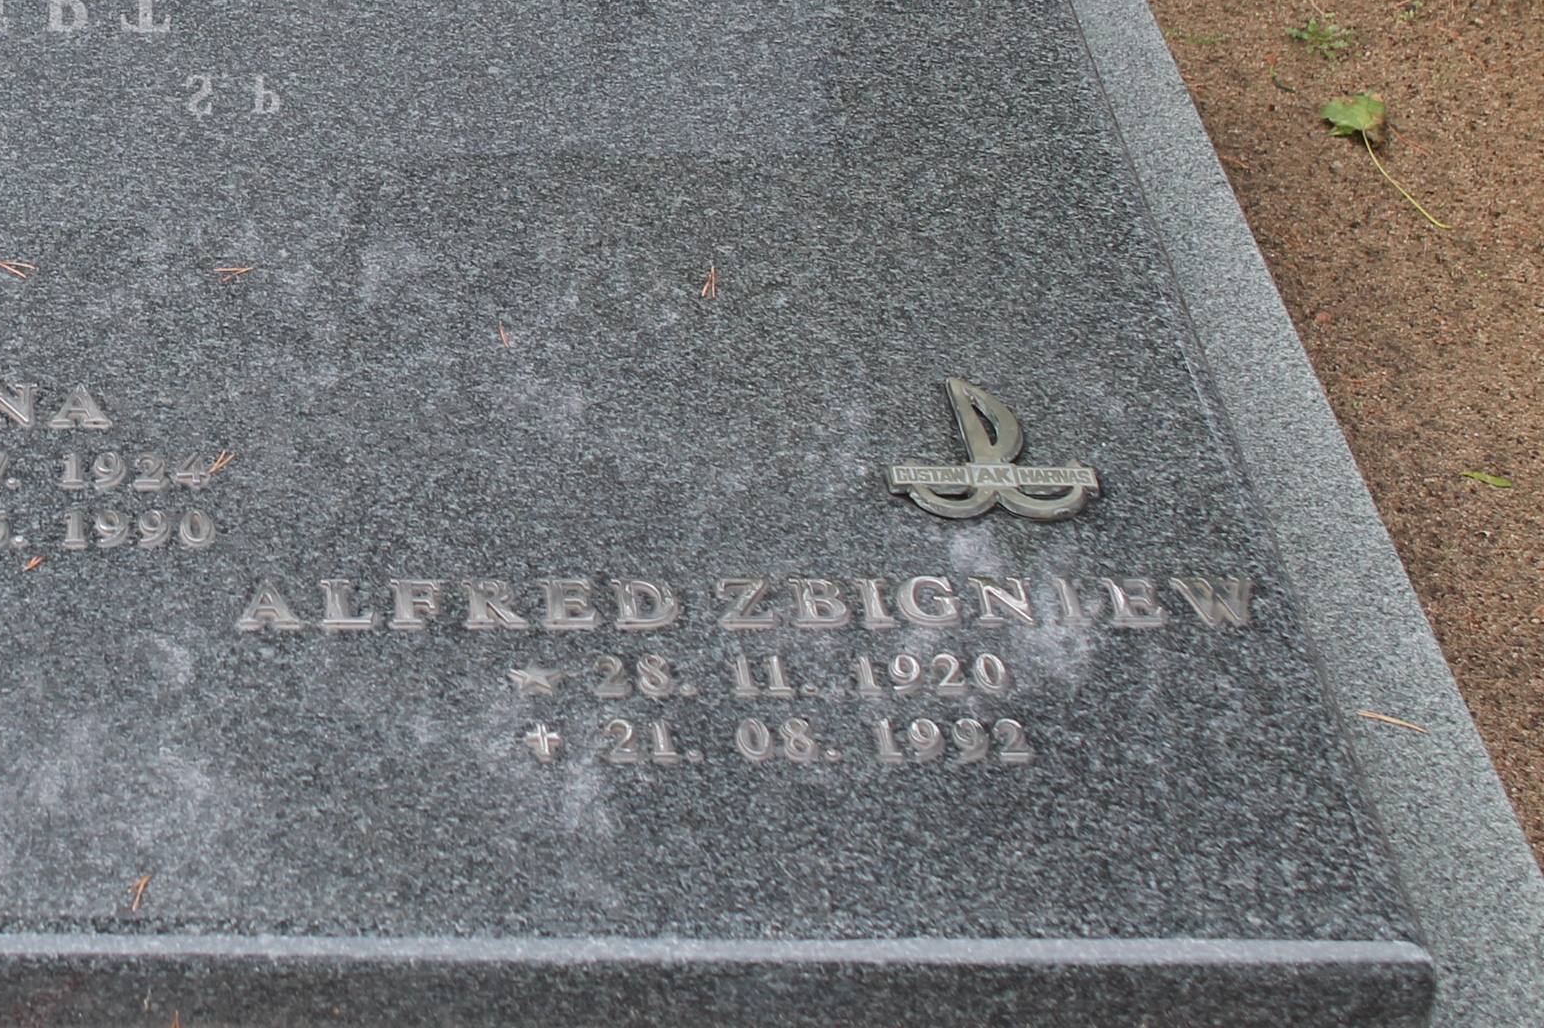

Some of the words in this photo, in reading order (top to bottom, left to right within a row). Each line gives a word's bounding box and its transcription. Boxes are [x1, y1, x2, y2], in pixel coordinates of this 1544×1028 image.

[62, 451, 213, 490] 1924
[976, 466, 1013, 484] AK
[62, 510, 216, 550] 1990
[236, 577, 679, 630] ALFRED
[716, 575, 1254, 628] ZBIGNIEW
[594, 654, 699, 699] 28.
[731, 653, 822, 698] 11.
[856, 652, 1008, 697] 1920
[603, 718, 704, 763] 21.
[735, 717, 844, 762] 08.
[876, 717, 1034, 763] 1992
